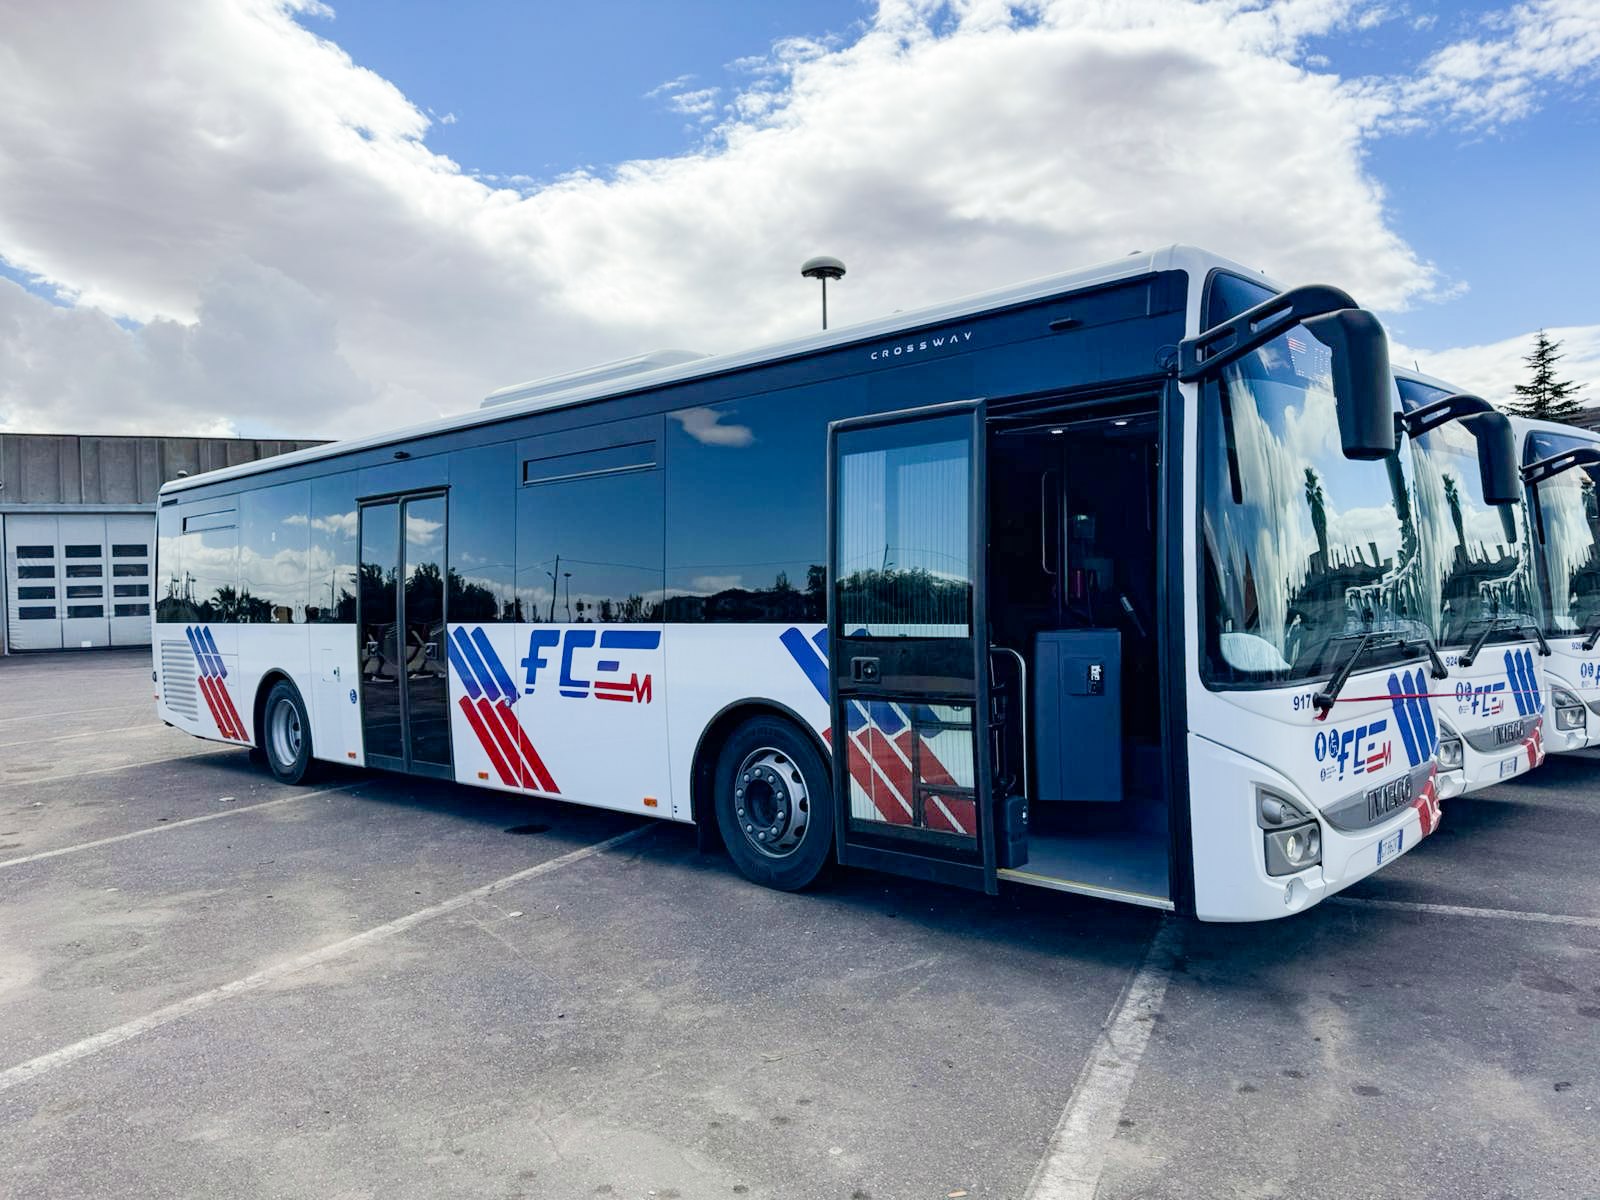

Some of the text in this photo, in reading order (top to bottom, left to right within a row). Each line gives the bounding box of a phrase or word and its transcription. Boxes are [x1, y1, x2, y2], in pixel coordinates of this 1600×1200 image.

[870, 331, 972, 360] CROSSWAY
[1293, 694, 1311, 711] 917
[1367, 774, 1411, 821] IVECO
